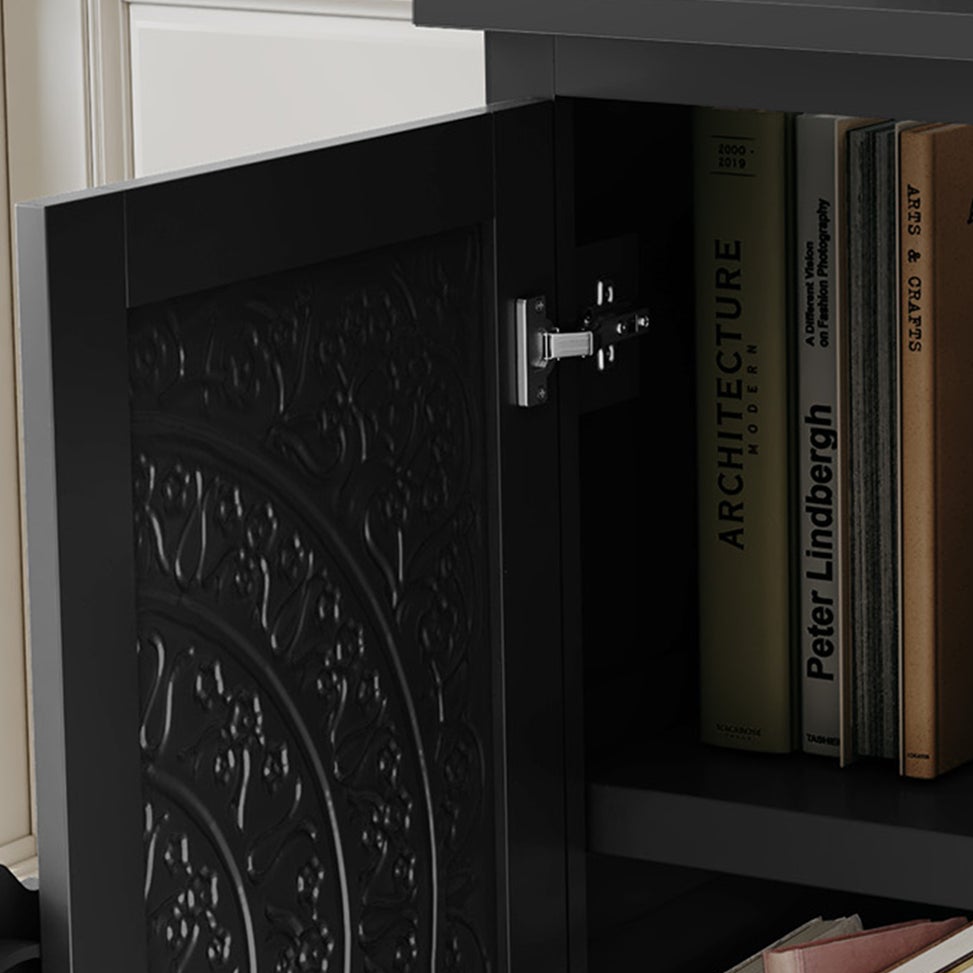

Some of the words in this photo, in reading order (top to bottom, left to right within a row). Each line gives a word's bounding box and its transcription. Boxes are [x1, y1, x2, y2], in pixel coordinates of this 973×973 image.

[718, 157, 746, 169] 2019
[907, 184, 922, 236] ARTS
[804, 241, 815, 279] Vision
[817, 198, 831, 277] Photography
[907, 249, 922, 263] &
[804, 282, 815, 335] Different
[817, 280, 830, 330] Fashion
[907, 275, 922, 352] CRAFTS
[804, 336, 815, 347] A
[819, 332, 829, 348] on
[715, 239, 744, 550] ARCHITECTURE
[746, 344, 758, 455] MODERN
[805, 404, 838, 582] Lindbergh
[806, 590, 835, 681] Peter
